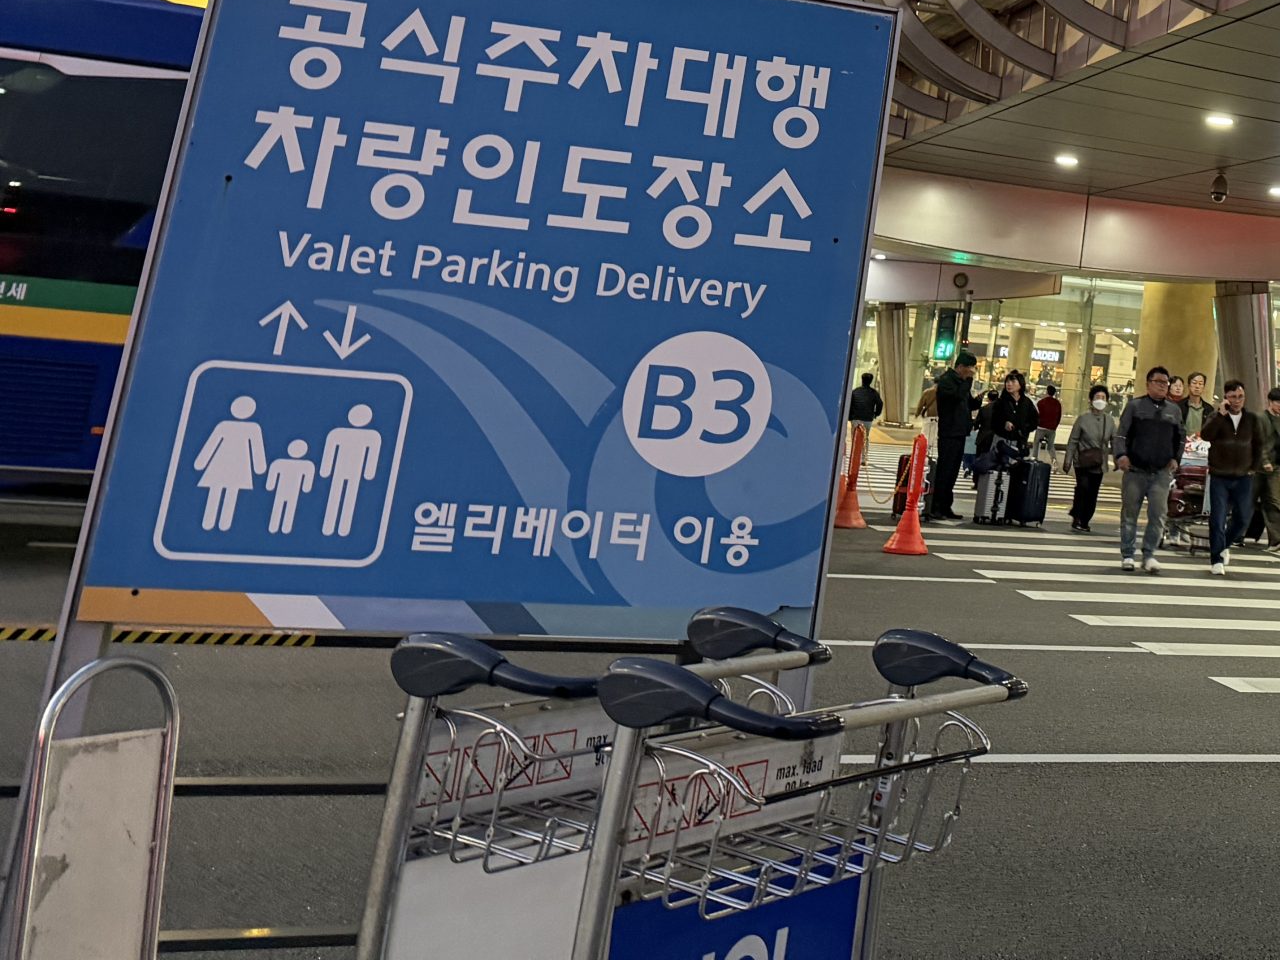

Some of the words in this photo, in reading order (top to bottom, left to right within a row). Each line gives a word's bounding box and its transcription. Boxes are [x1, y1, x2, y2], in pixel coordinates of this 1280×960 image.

[244, 106, 813, 252] 차량인도장소
[278, 230, 396, 277] Valet
[412, 244, 580, 303] Parking
[595, 263, 767, 319] Delivery
[1031, 350, 1059, 361] ARDEN
[637, 364, 755, 444] B3
[411, 502, 650, 561] 엘리베이터
[673, 516, 759, 567] 이용
[776, 764, 799, 780] max.
[803, 755, 824, 775] load
